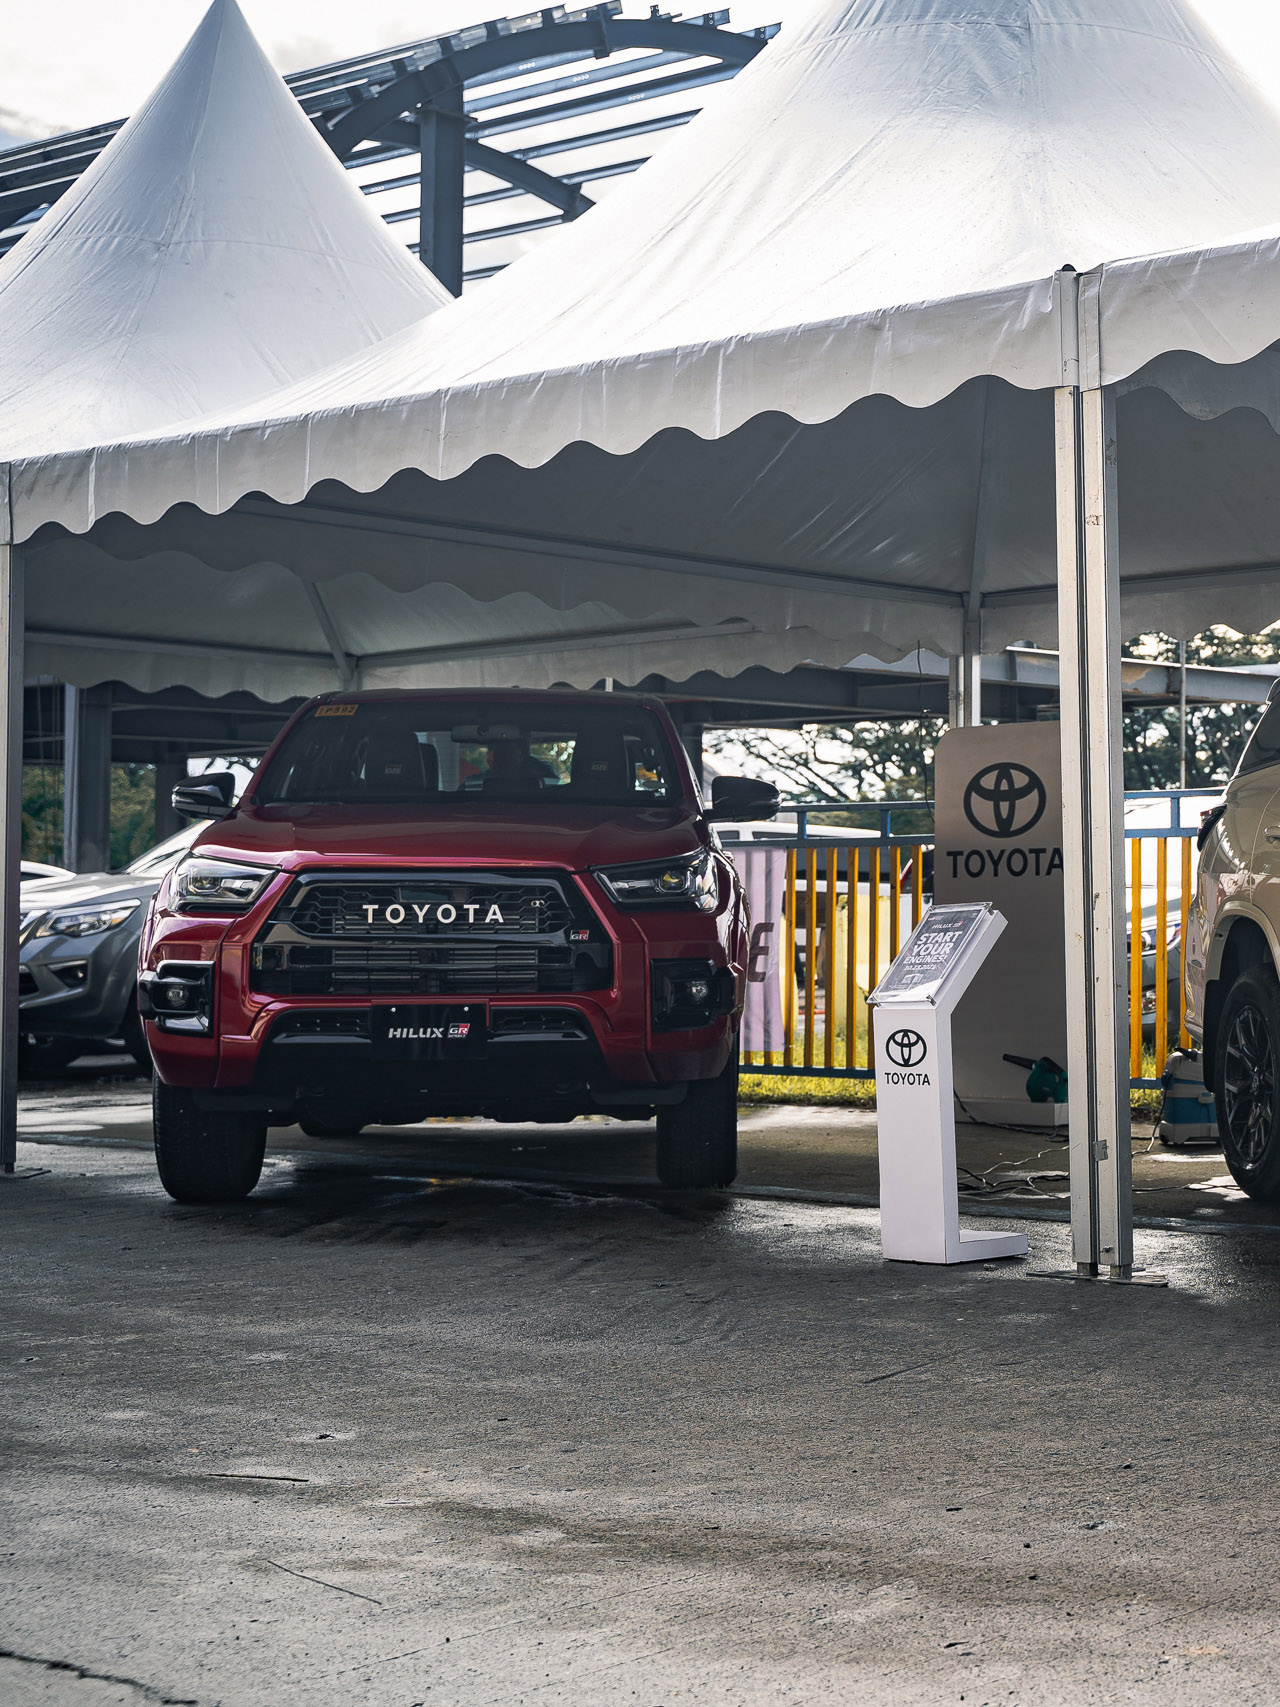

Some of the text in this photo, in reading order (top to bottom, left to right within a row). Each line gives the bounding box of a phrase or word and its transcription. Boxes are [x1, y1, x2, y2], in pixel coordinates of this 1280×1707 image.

[946, 847, 1063, 878] TOYOTA
[362, 904, 504, 924] TOYOTA
[917, 931, 963, 944] START
[912, 943, 954, 956] YOUR
[903, 954, 948, 964] ENGINES!
[388, 1026, 469, 1038] HILUX GR
[884, 1072, 931, 1086] TOYOTA
